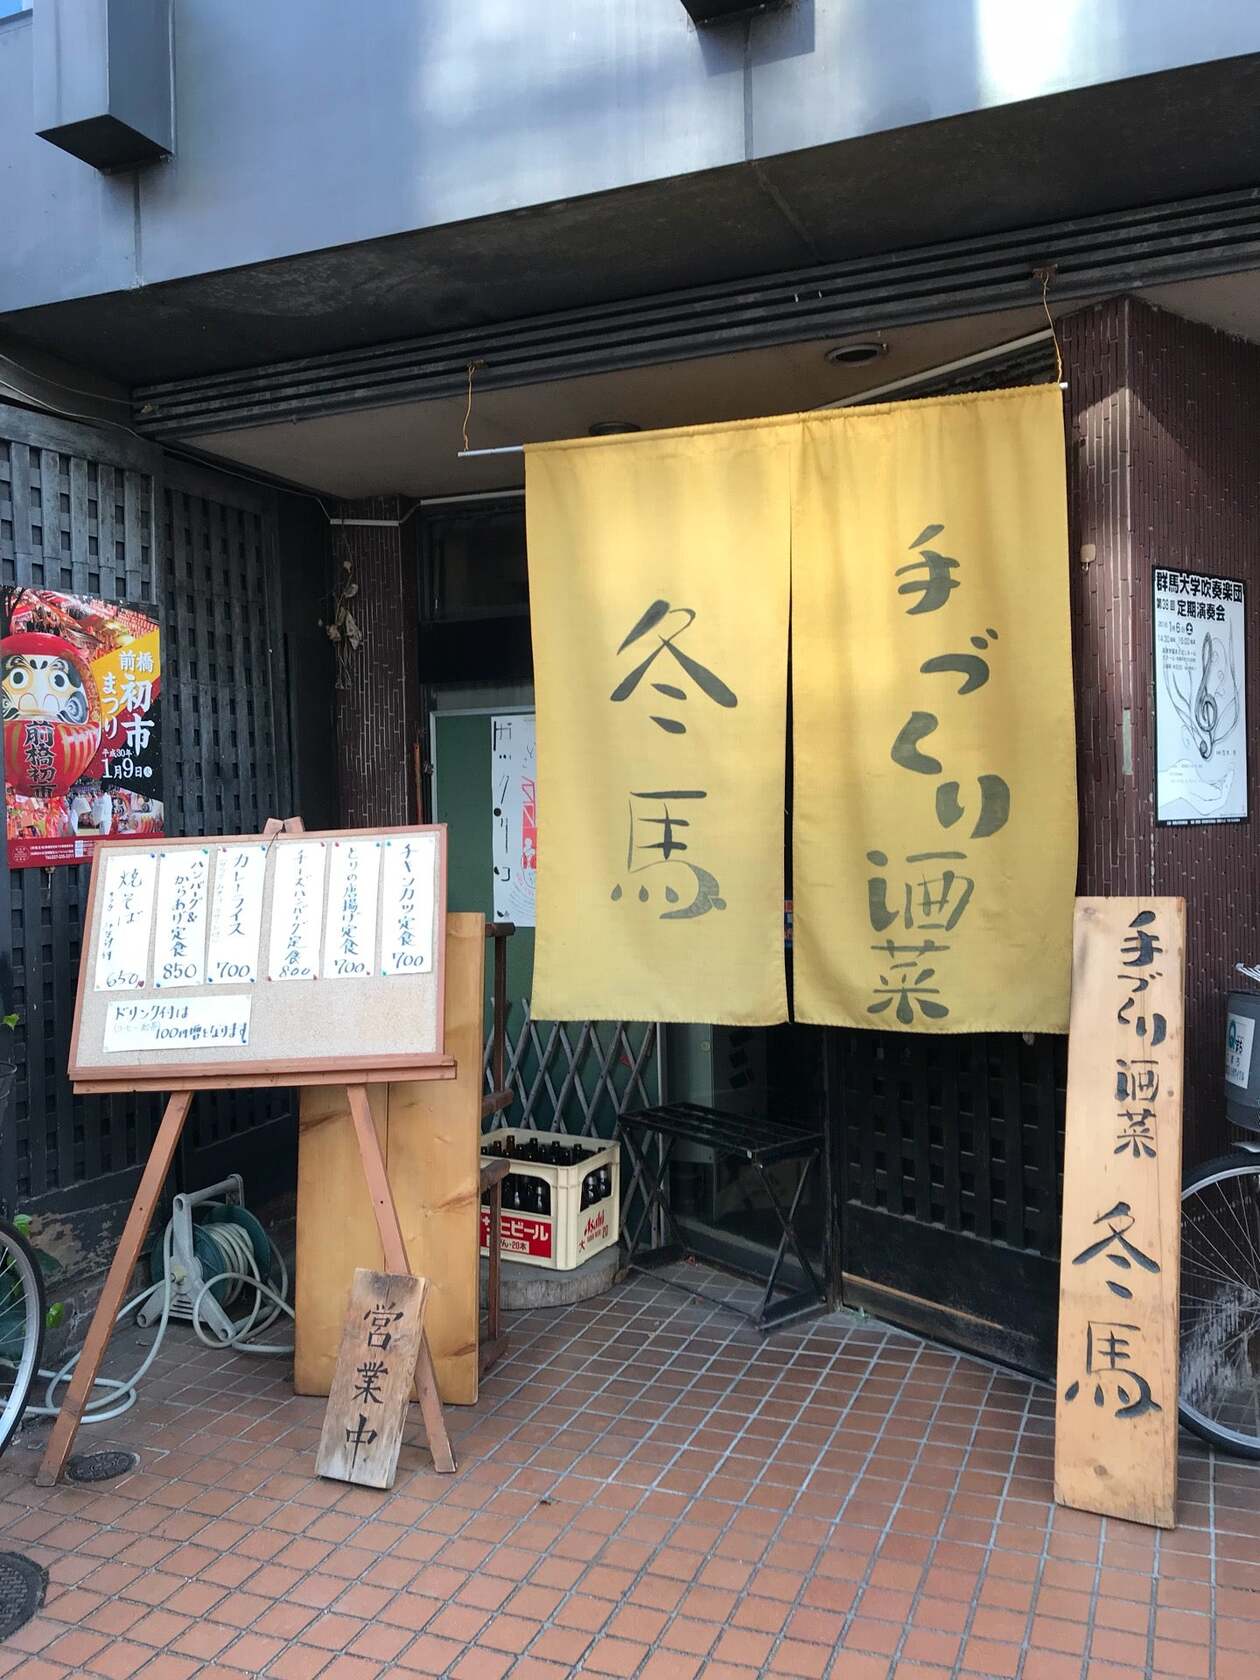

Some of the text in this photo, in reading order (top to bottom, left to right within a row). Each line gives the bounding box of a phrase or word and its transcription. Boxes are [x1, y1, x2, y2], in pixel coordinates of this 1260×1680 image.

[1156, 571, 1243, 603] 群馬大学吹奏楽団
[1177, 600, 1226, 621] 定期演奏会
[119, 650, 154, 672] 前橋
[101, 671, 121, 740] まつり
[120, 672, 155, 757] 初市
[101, 748, 133, 759] 平成30年
[610, 599, 738, 919] 冬馬
[866, 524, 1011, 1024] 手づくり酒菜
[228, 853, 249, 936] カレーライス
[162, 962, 197, 980] 850
[216, 962, 250, 979] 700
[334, 958, 366, 975] 700
[391, 951, 424, 969] 700
[106, 969, 139, 988] 650
[279, 966, 311, 978] 800
[1065, 910, 1167, 1418] 手づくり酒菜 冬馬
[346, 1302, 404, 1469] 営業中
